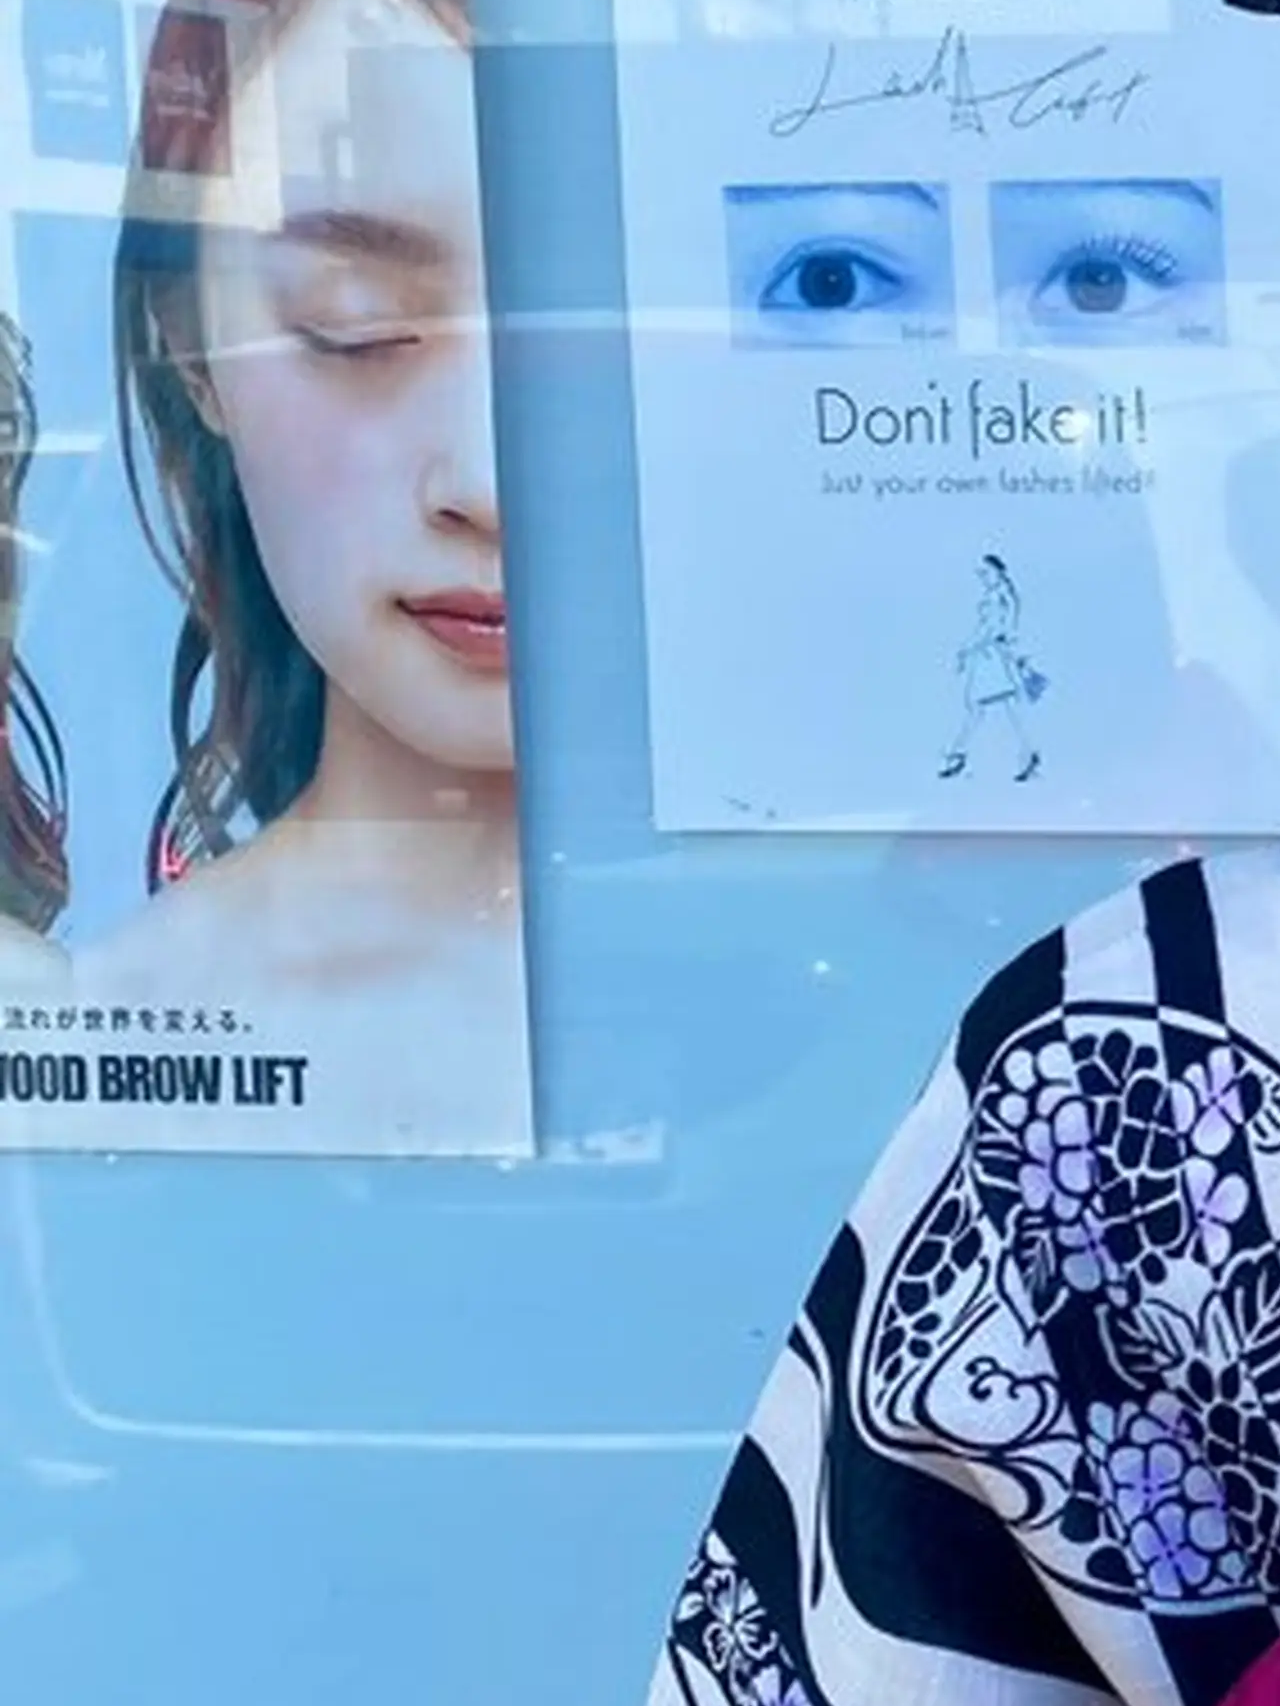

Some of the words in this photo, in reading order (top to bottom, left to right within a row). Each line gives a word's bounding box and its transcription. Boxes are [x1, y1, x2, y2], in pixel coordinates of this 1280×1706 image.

[968, 378, 1078, 462] fake
[1099, 386, 1149, 445] it!
[872, 472, 926, 502] your
[997, 465, 1074, 495] lashes
[0, 1051, 88, 1104] OOD
[97, 1054, 222, 1104] BROW
[232, 1055, 308, 1106] LIFT
